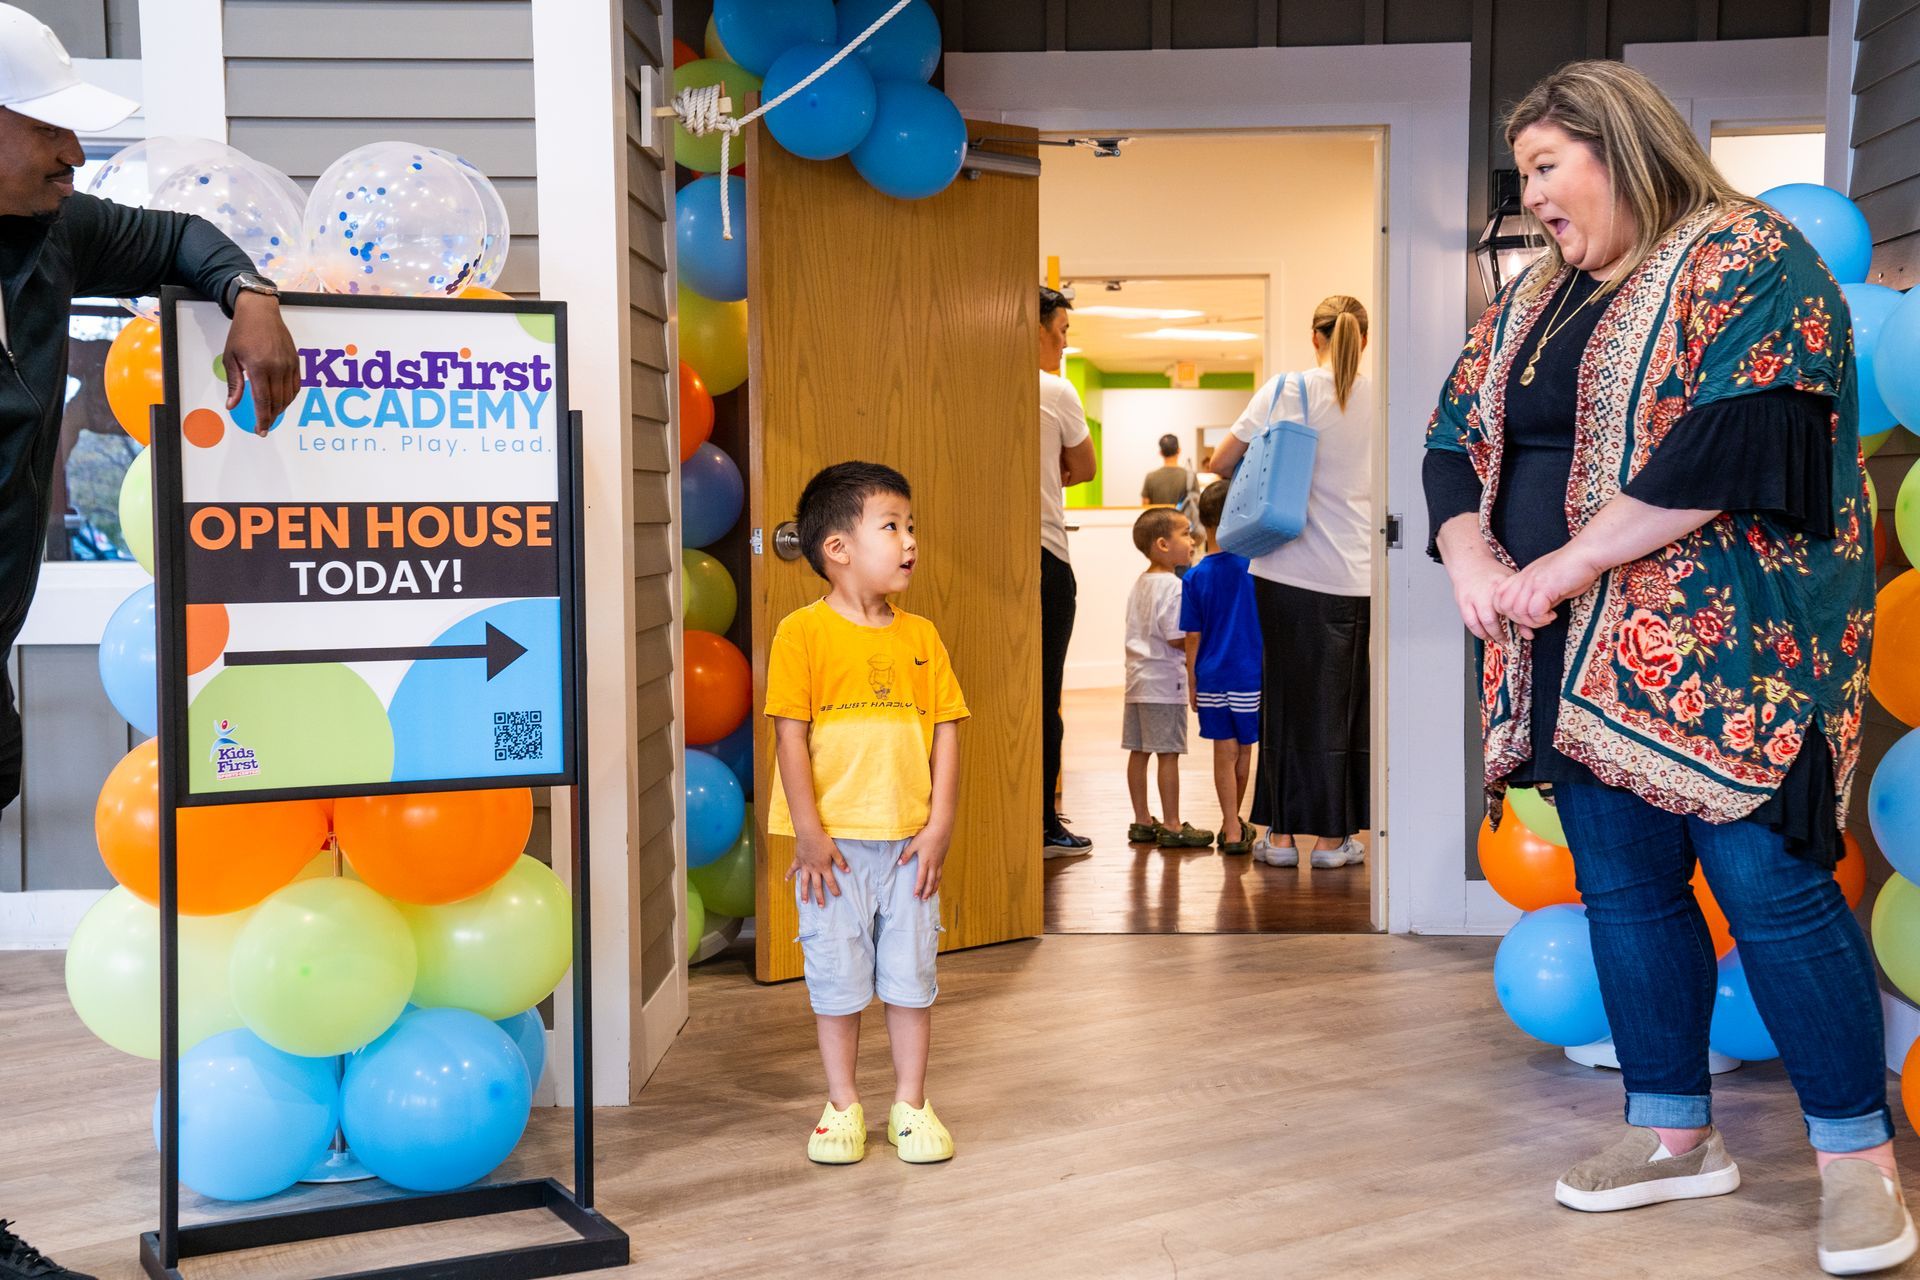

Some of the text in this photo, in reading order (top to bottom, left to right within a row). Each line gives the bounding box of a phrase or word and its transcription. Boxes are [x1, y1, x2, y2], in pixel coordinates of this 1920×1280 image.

[298, 344, 552, 392] KidsFirst
[297, 388, 549, 430] ACADEMY
[299, 434, 552, 457] Learn. Play. Lead.
[189, 505, 552, 551] OPEN HOUSE
[289, 558, 463, 596] TODAY!
[216, 758, 259, 773] First
[218, 747, 255, 760] Kids
